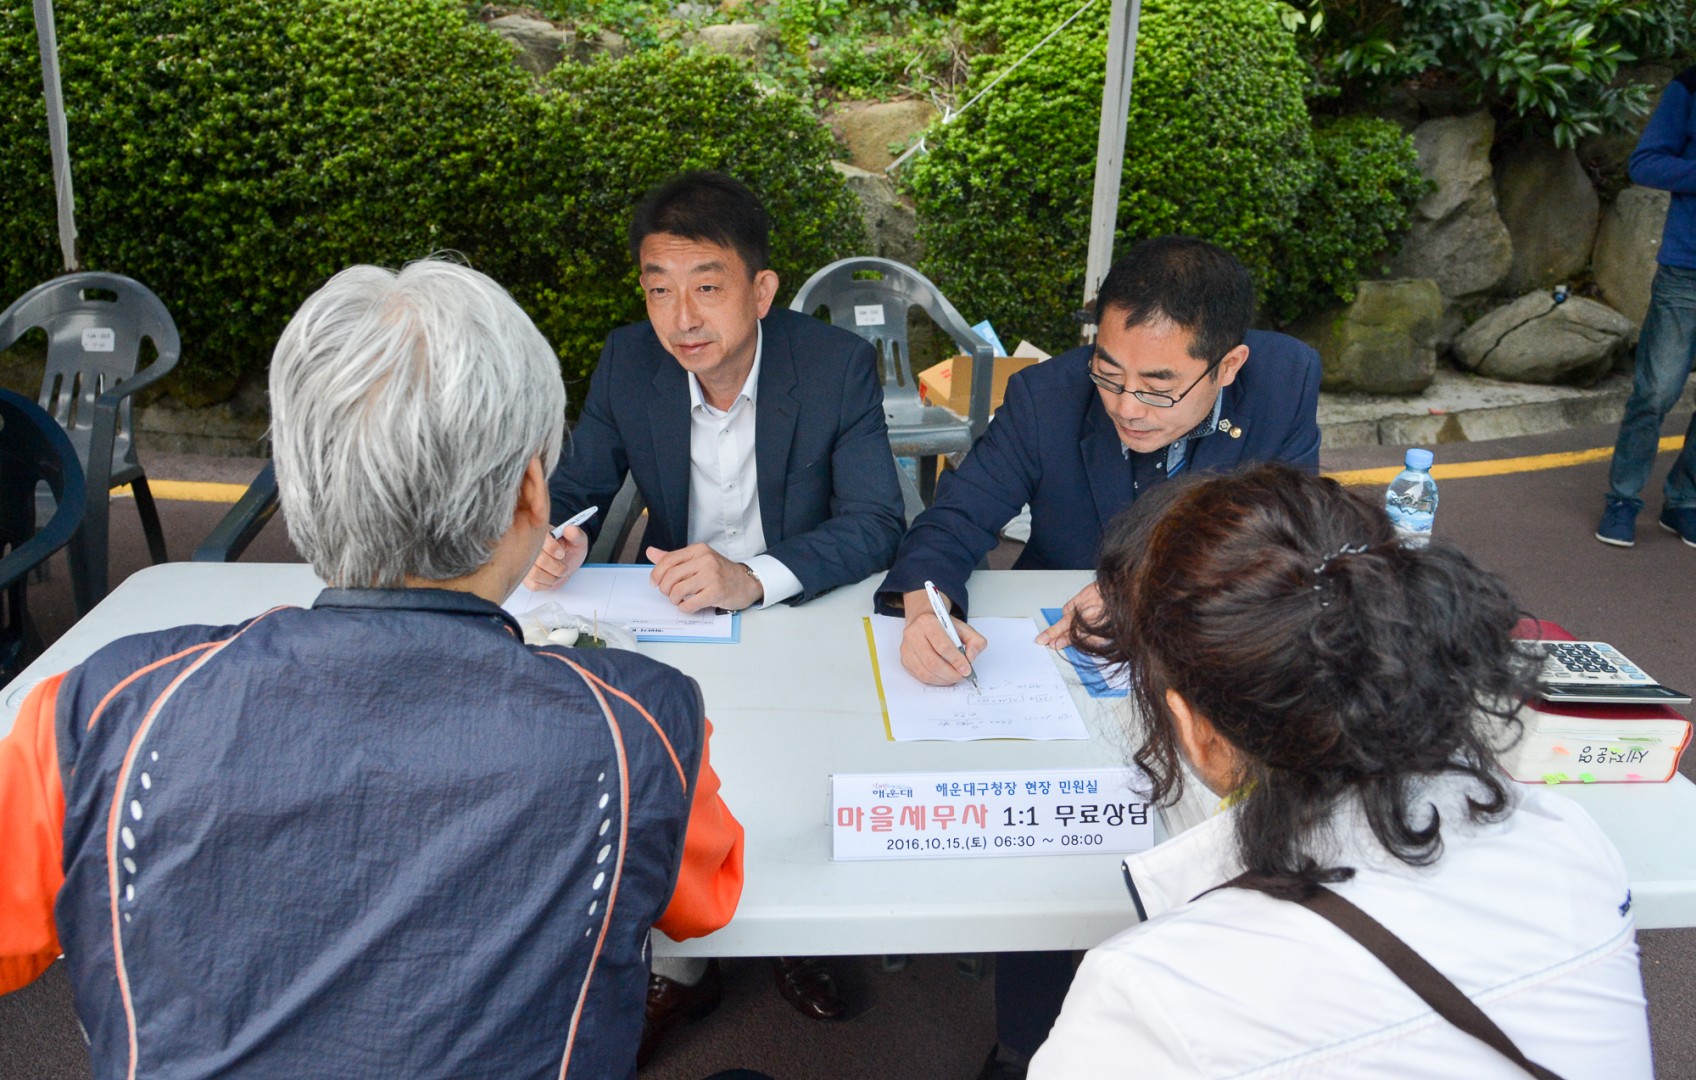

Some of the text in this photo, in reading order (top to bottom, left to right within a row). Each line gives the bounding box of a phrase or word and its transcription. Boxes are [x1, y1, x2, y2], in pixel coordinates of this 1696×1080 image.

[936, 779, 1098, 797] 해운대구청장 현장 민원실
[837, 802, 1150, 832] 마을세무사 1:1 무료상담
[886, 836, 988, 851] 2016.10.15.(토)
[994, 835, 1036, 848] 06:30
[1061, 833, 1104, 847] 08:00
